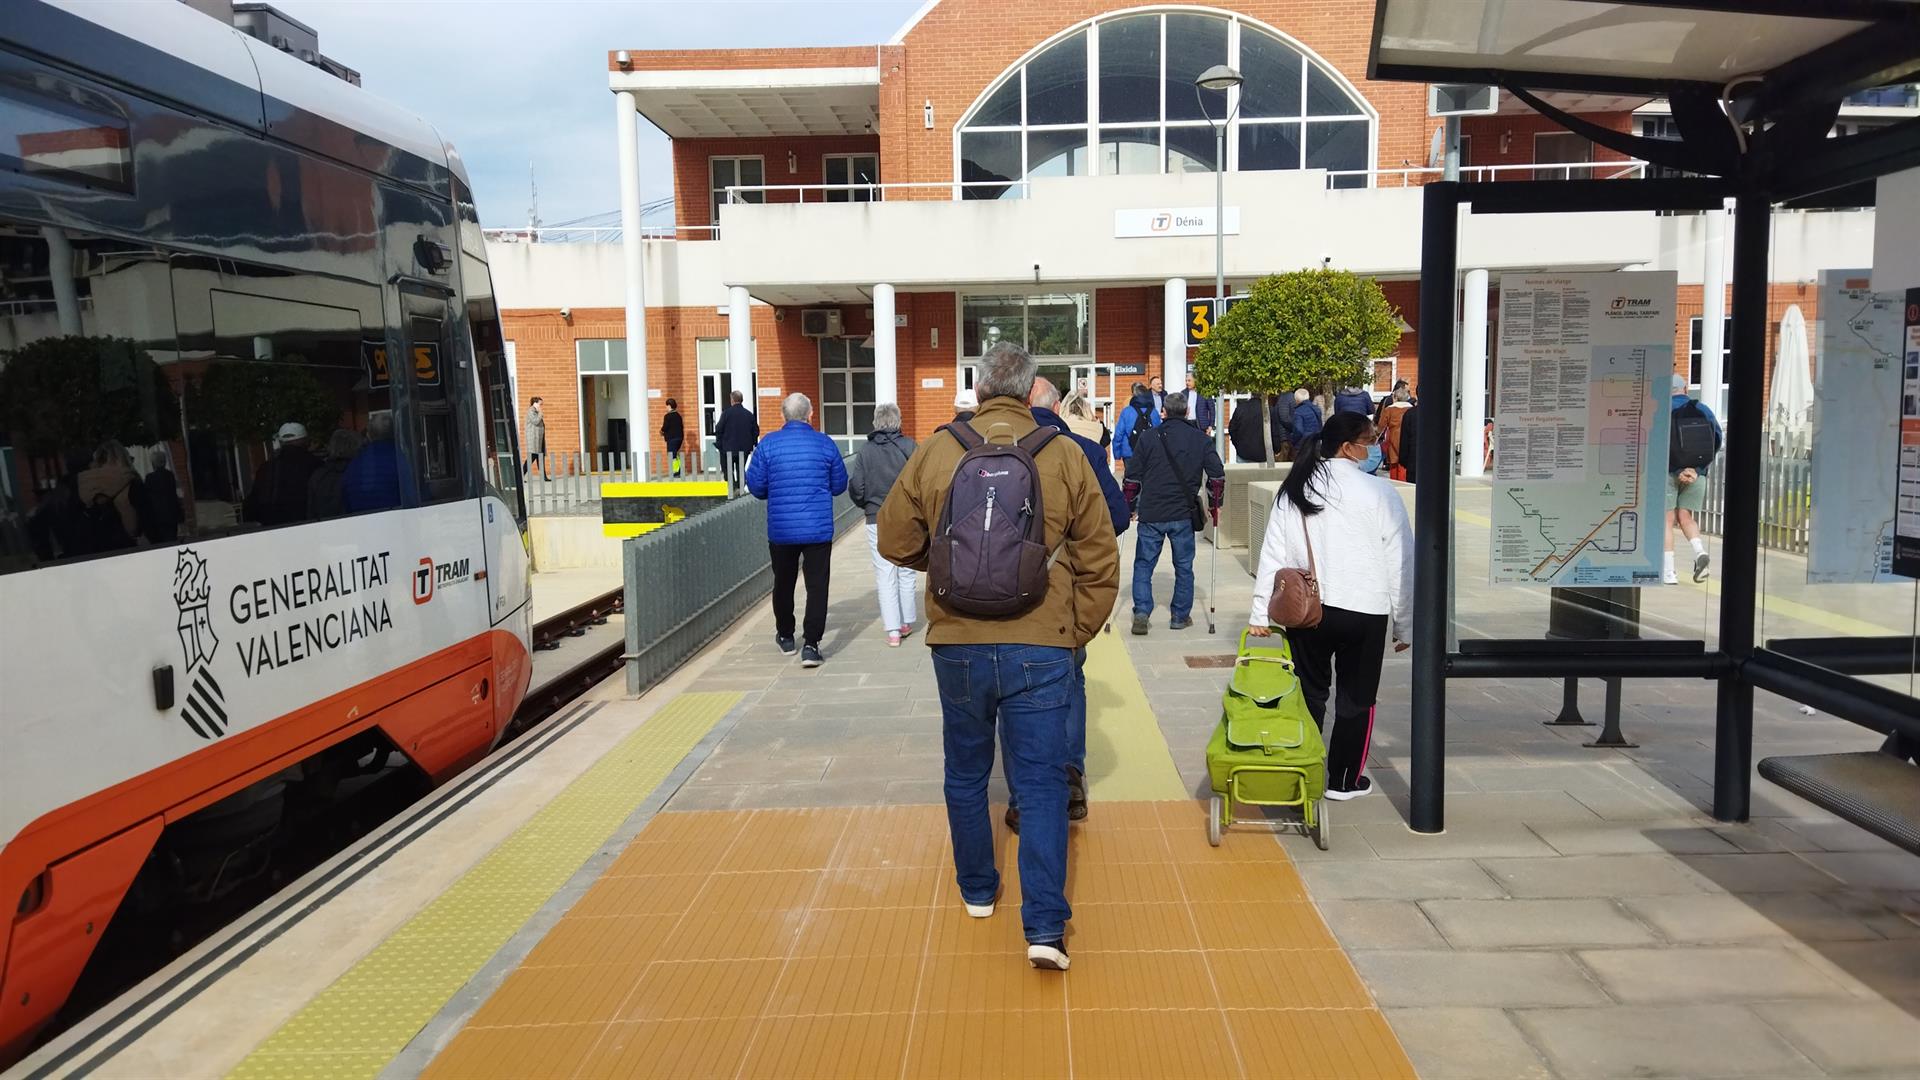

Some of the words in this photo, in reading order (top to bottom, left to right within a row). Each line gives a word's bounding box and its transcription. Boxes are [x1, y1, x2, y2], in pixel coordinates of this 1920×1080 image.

[1175, 216, 1203, 227] Dénia
[1191, 305, 1210, 339] 3
[1609, 357, 1616, 365] C
[435, 558, 470, 583] TRAM
[229, 551, 391, 625] GENERALITAT
[236, 598, 394, 679] VALENCIANA
